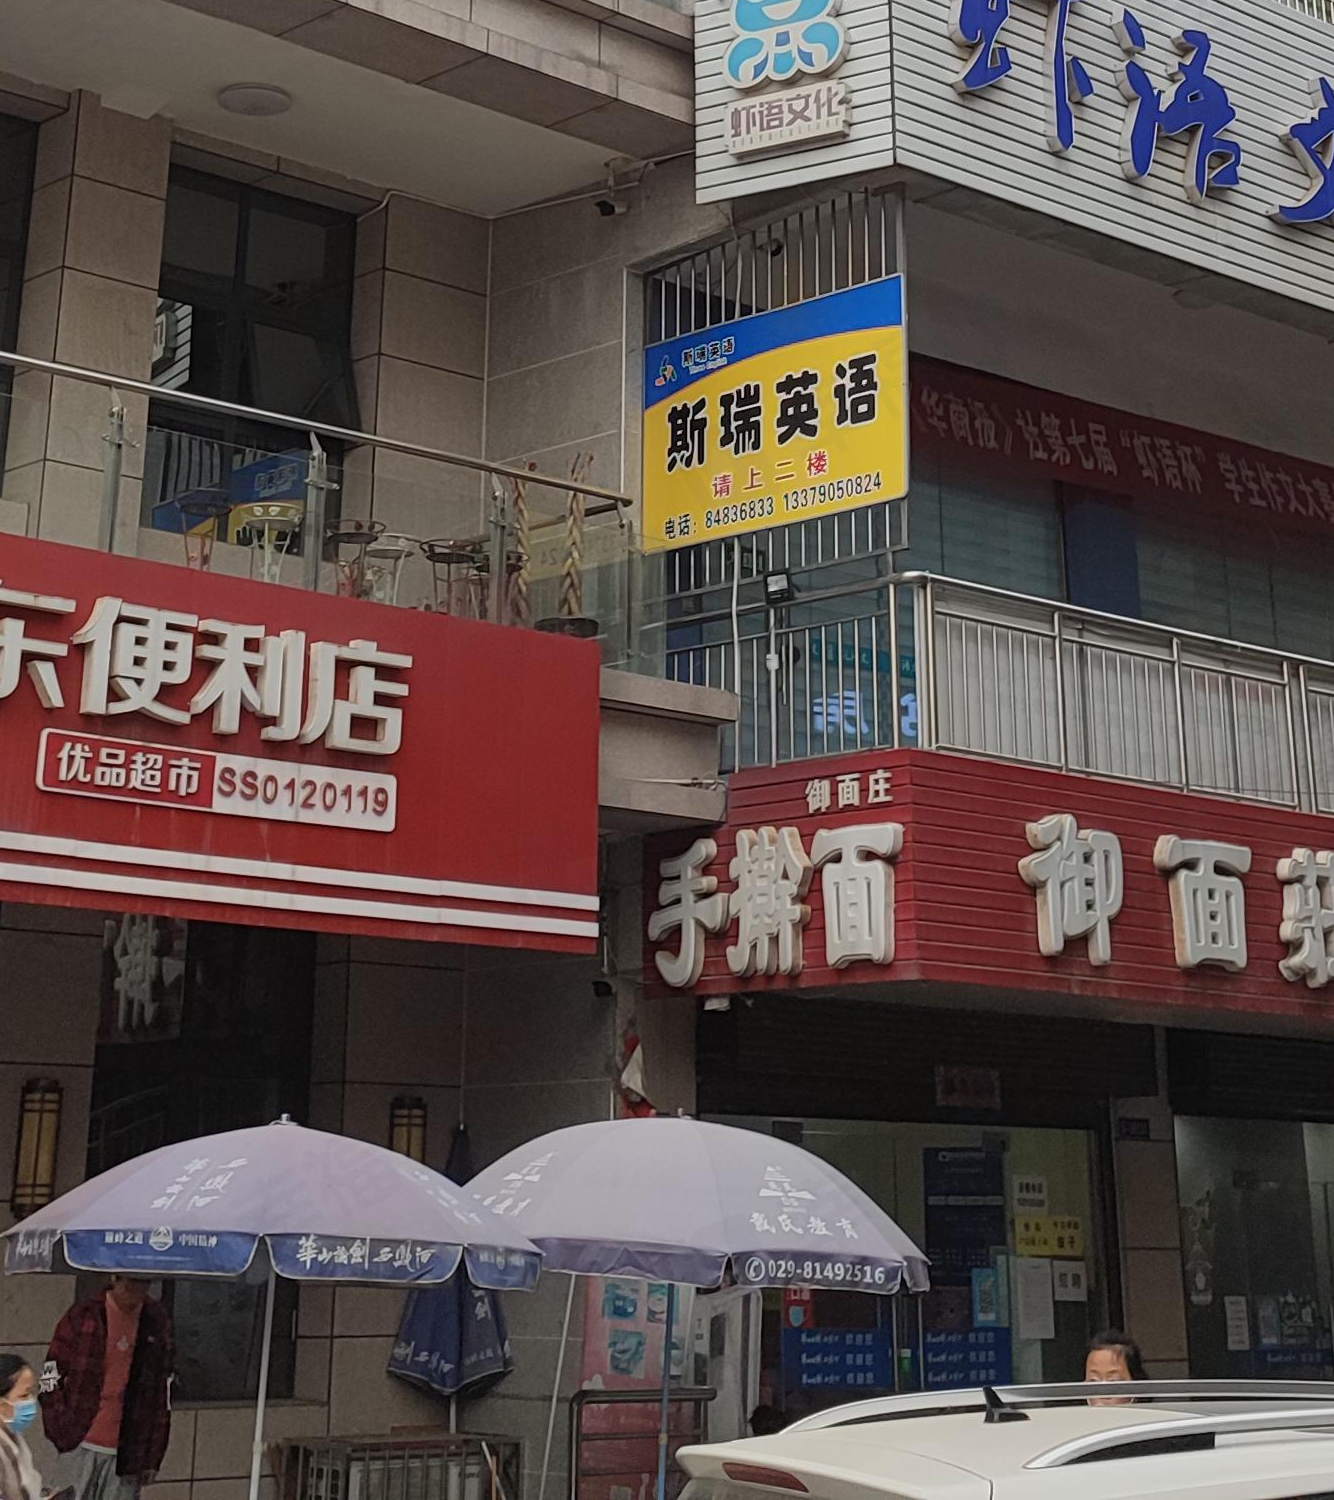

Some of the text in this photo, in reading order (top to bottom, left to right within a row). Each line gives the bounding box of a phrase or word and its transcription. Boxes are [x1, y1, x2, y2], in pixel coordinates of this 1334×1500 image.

[730, 86, 840, 138] 虾语文化
[667, 353, 879, 473] 斯瑞英语
[712, 450, 829, 498] 请上二楼
[664, 471, 883, 540] 电话： 84836833 13379050824
[56, 739, 391, 818] 优品超市 SS0120119
[805, 769, 894, 815] 御面庄
[648, 820, 905, 989] 手擀面
[767, 1259, 886, 1286] 029-81492516
